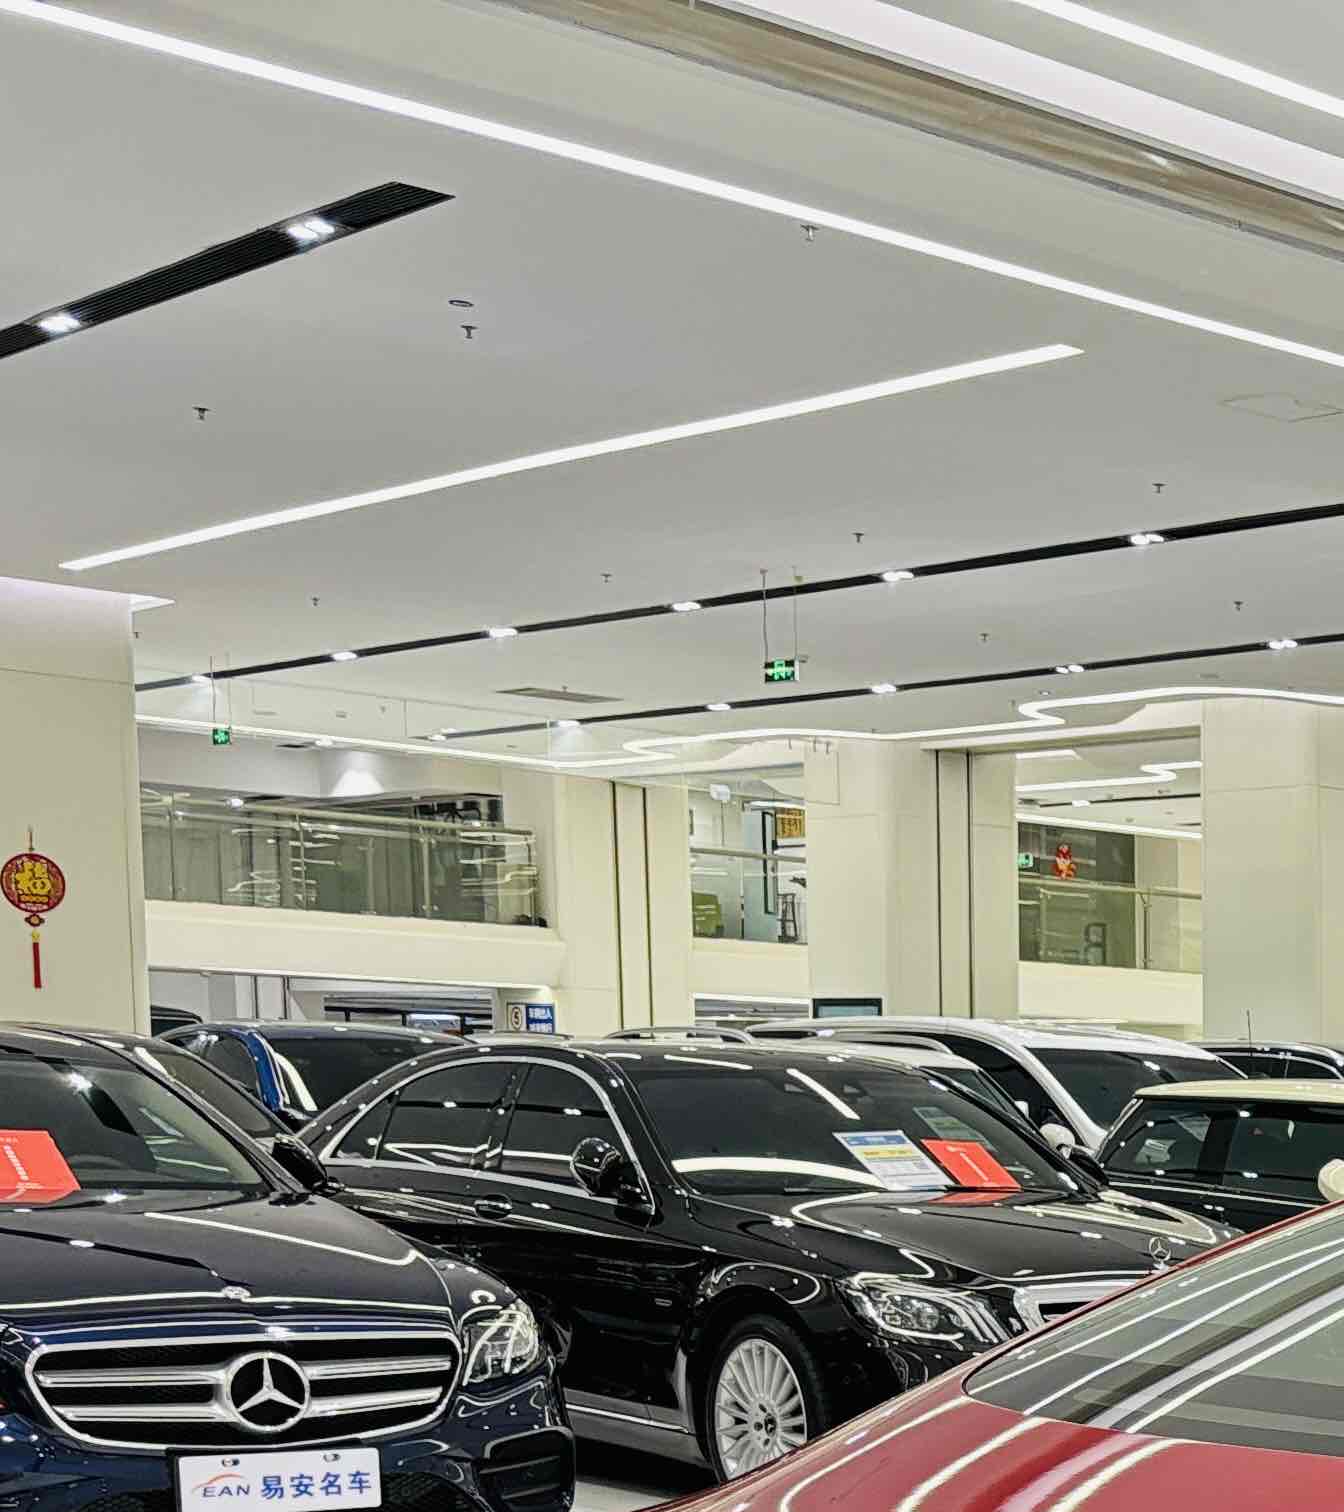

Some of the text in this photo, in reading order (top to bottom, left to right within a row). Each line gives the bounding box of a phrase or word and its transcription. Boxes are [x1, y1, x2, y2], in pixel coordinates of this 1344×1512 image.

[201, 1470, 373, 1501] EAN 易安名车
